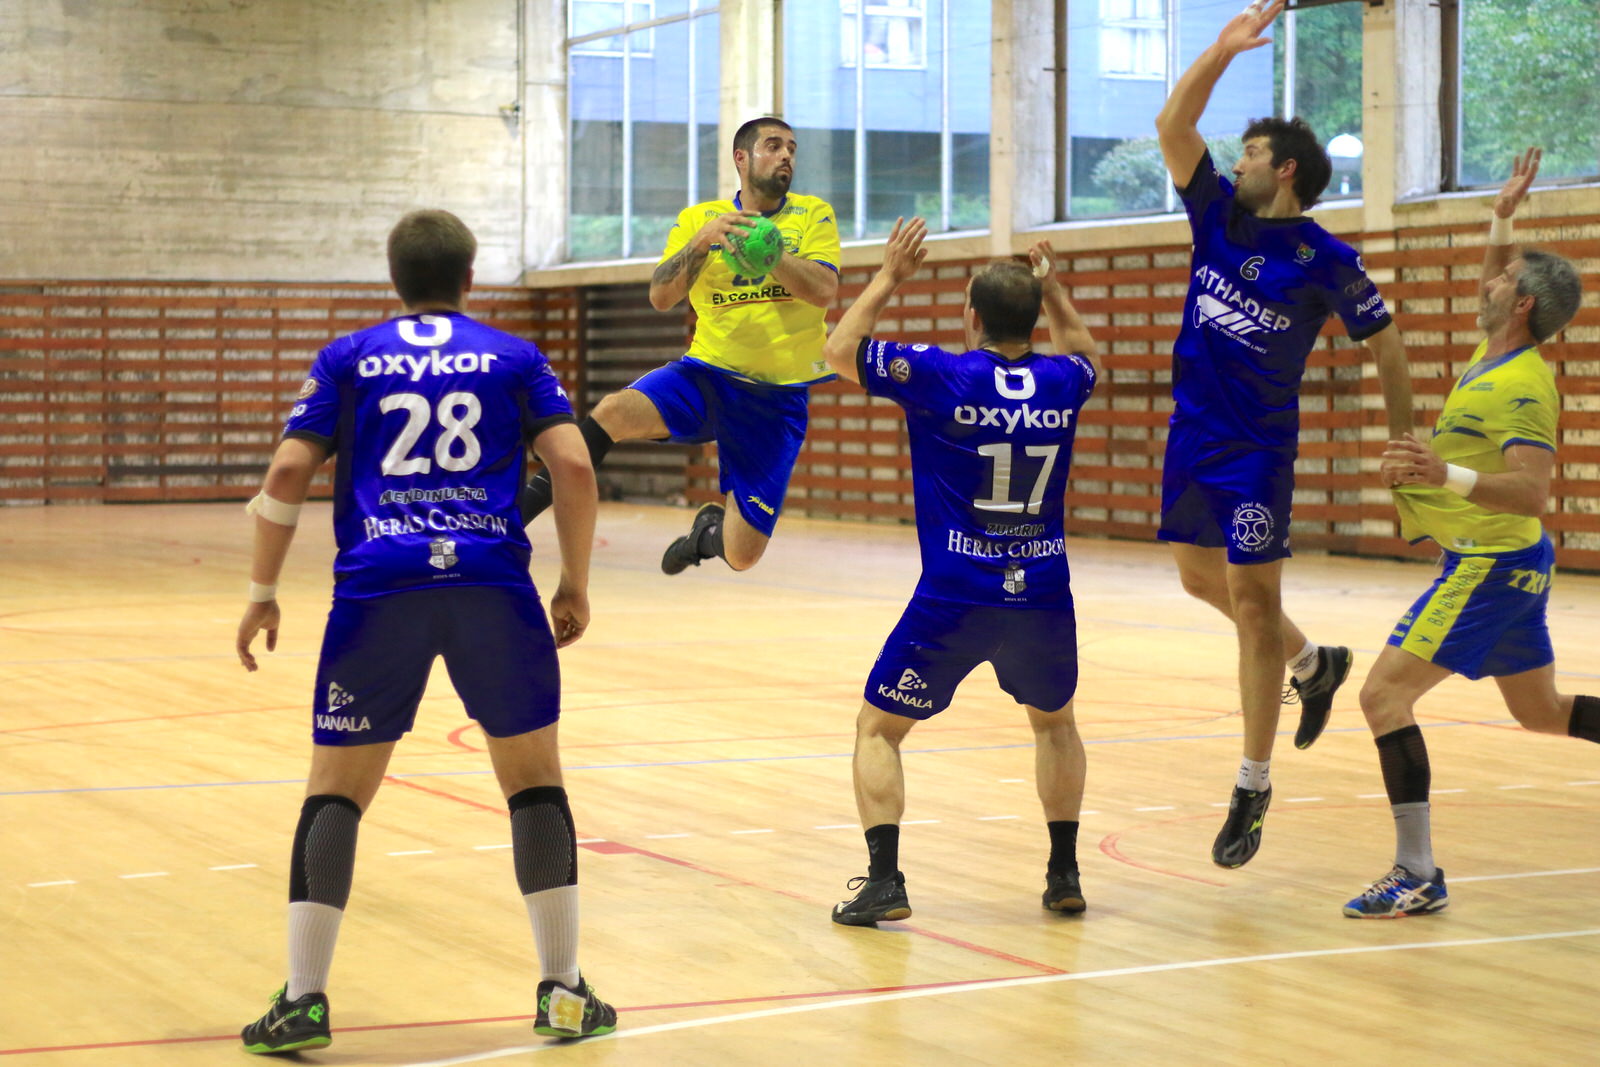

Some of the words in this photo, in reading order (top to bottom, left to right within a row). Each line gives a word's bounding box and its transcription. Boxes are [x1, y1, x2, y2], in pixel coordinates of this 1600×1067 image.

[1239, 255, 1266, 281] 6
[712, 293, 726, 305] EL
[1195, 265, 1292, 331] ATHADER
[357, 350, 498, 382] oxykor
[953, 403, 1074, 434] oxykor
[379, 391, 483, 476] 28
[973, 442, 1061, 515] 17
[379, 486, 488, 505] MENDINUETA
[363, 515, 425, 542] HERAS
[985, 523, 1045, 537] ZUBIRIA
[947, 529, 1003, 559] HERAS
[877, 683, 934, 709] KANALA
[316, 713, 372, 732] KANALA
